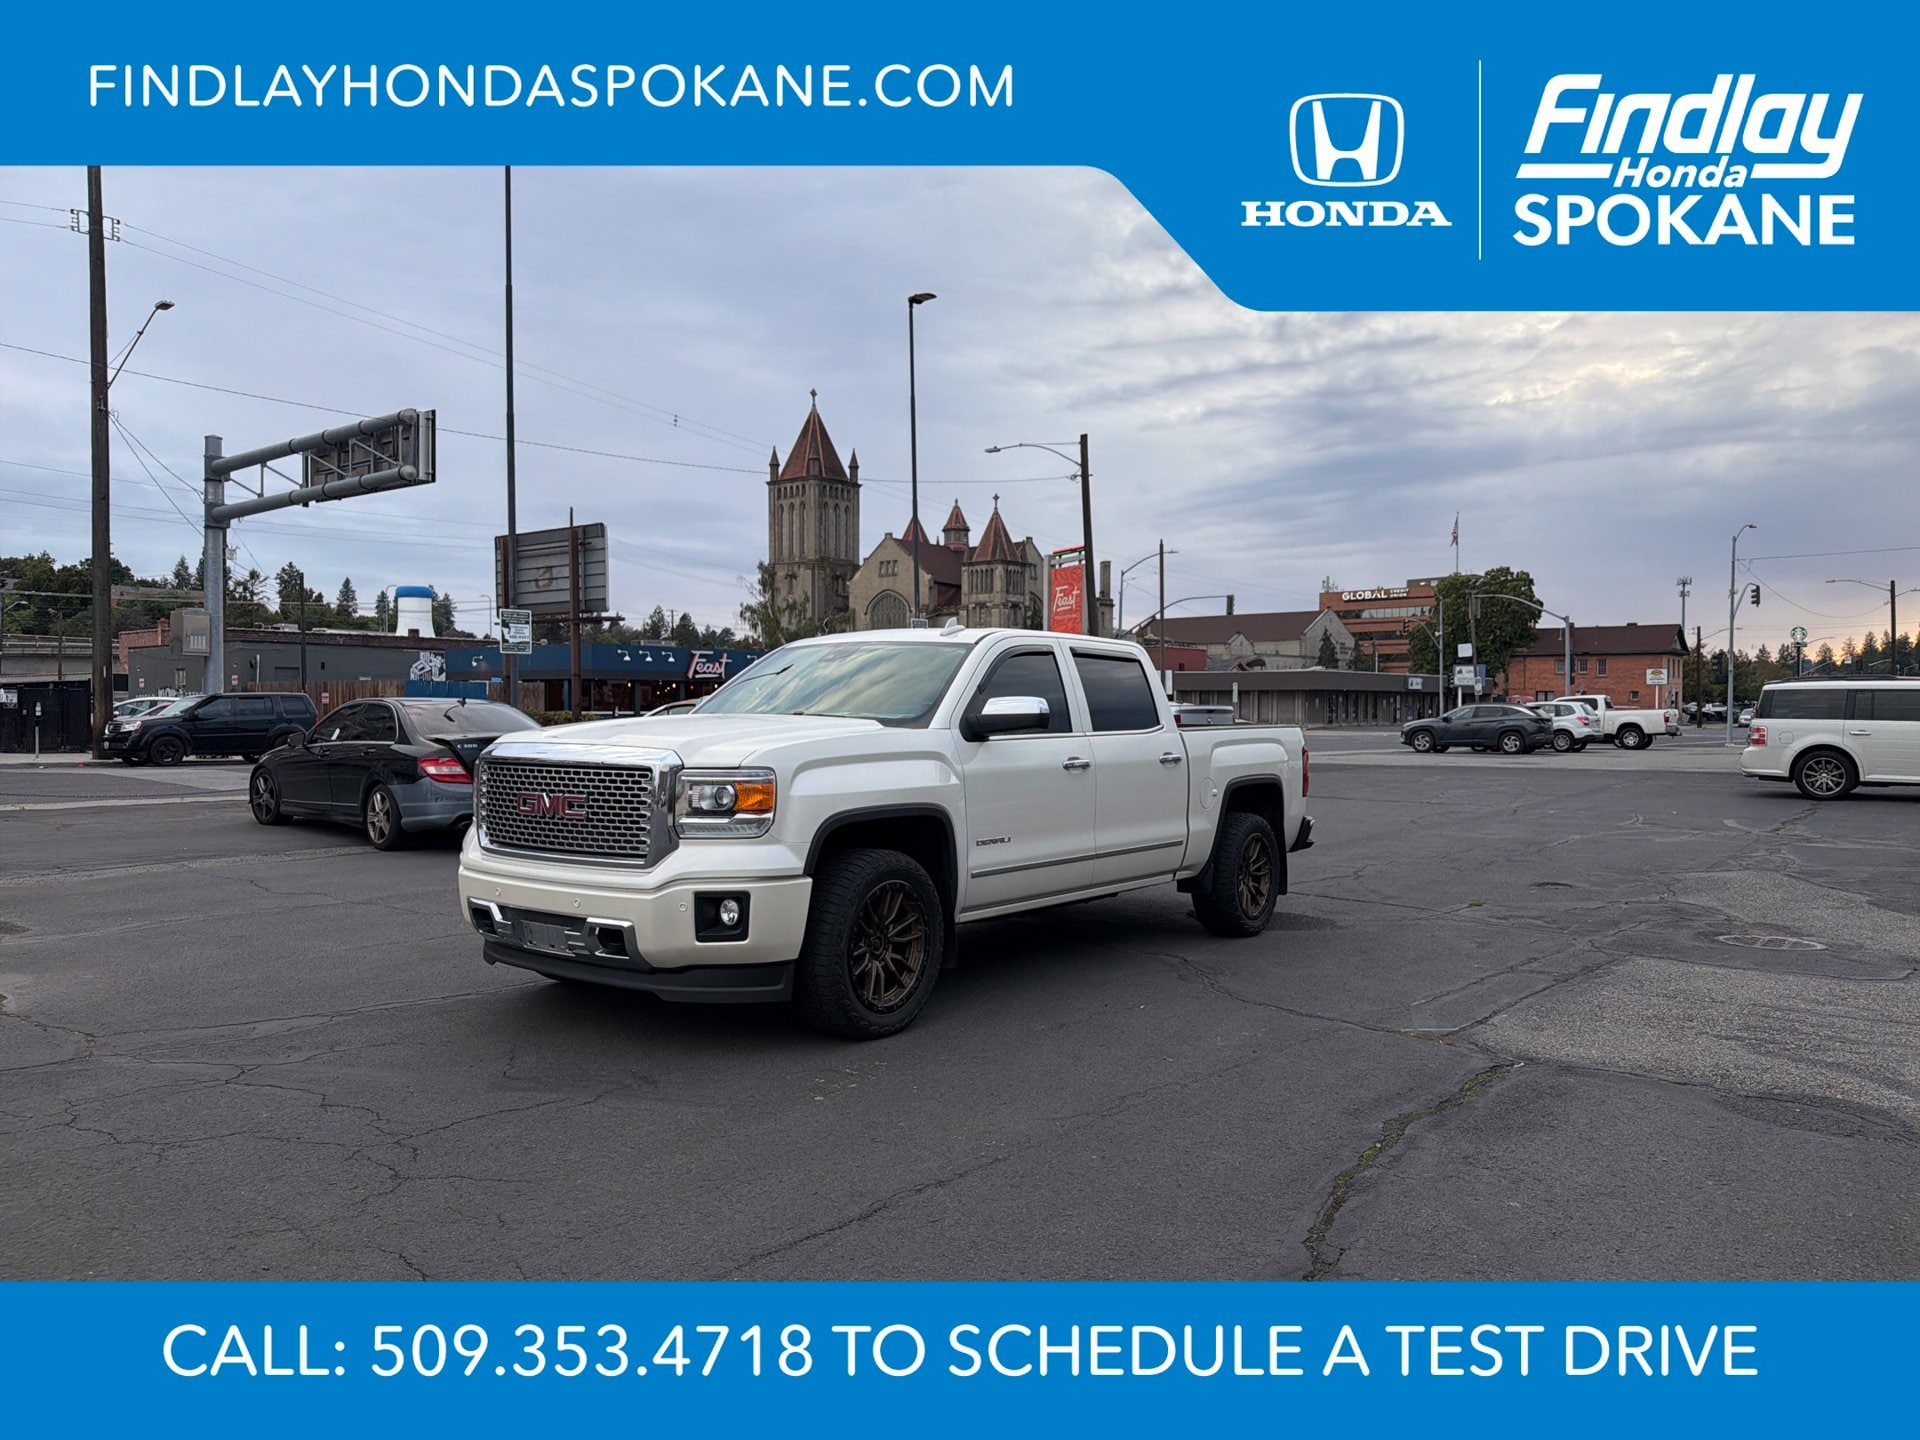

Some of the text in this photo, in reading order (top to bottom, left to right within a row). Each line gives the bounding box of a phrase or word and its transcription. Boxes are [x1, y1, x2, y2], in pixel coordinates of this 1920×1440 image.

[1053, 585, 1080, 612] Feast
[1341, 588, 1388, 601] GLOBAL
[687, 650, 733, 679] Feast
[516, 791, 587, 819] GMC
